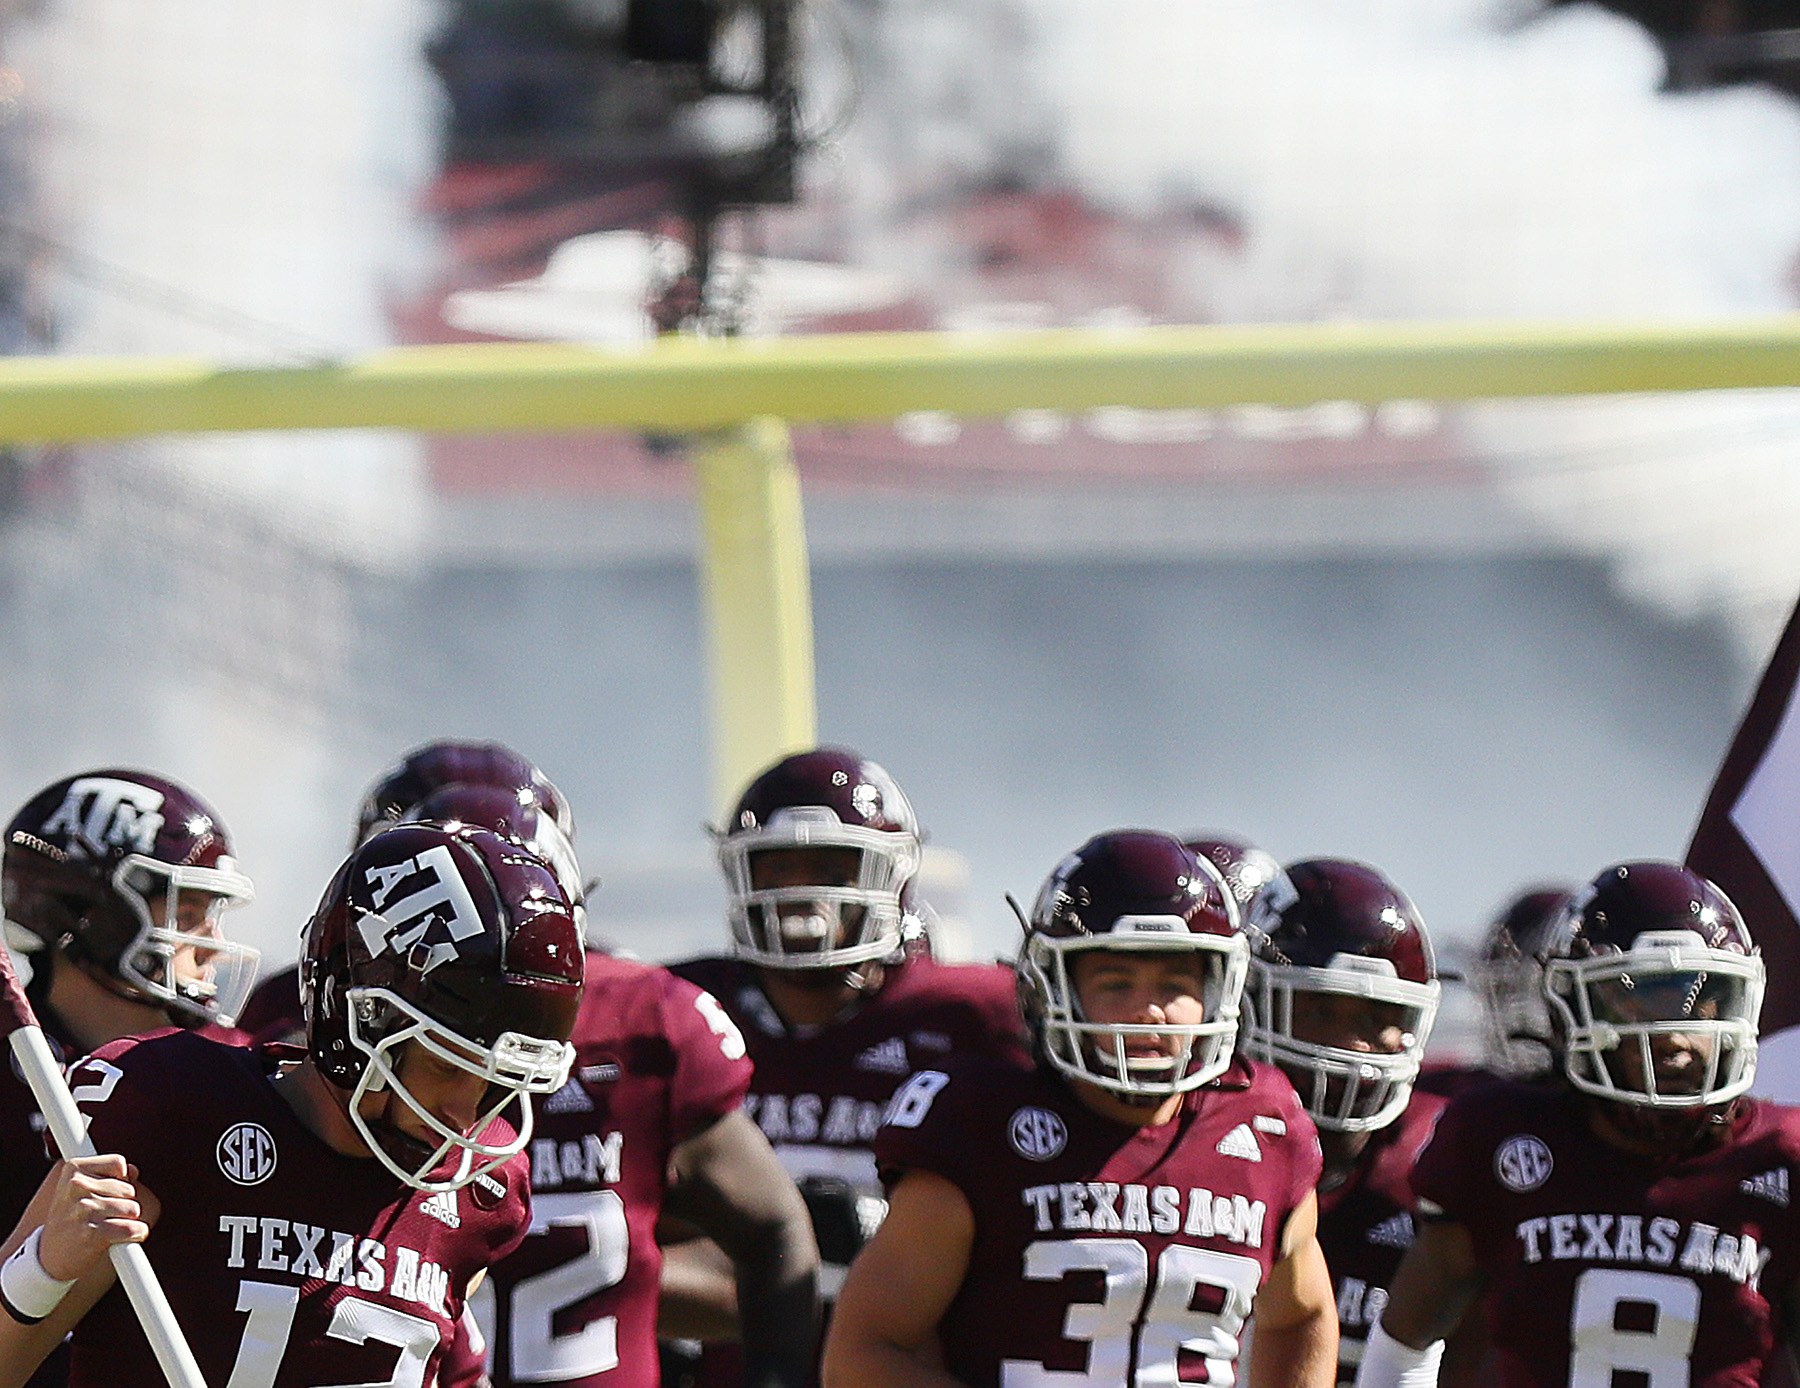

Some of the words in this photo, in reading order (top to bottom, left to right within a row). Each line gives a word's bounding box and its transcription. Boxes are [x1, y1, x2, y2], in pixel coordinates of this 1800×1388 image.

[221, 1126, 273, 1182] SEC
[1013, 1110, 1063, 1157] SEC
[1021, 1180, 1180, 1235] TEXAS
[1183, 1186, 1267, 1248] A&M
[1515, 1213, 1680, 1267] TEXAS
[219, 1215, 387, 1292] TEXAS
[390, 1246, 452, 1319] A&M
